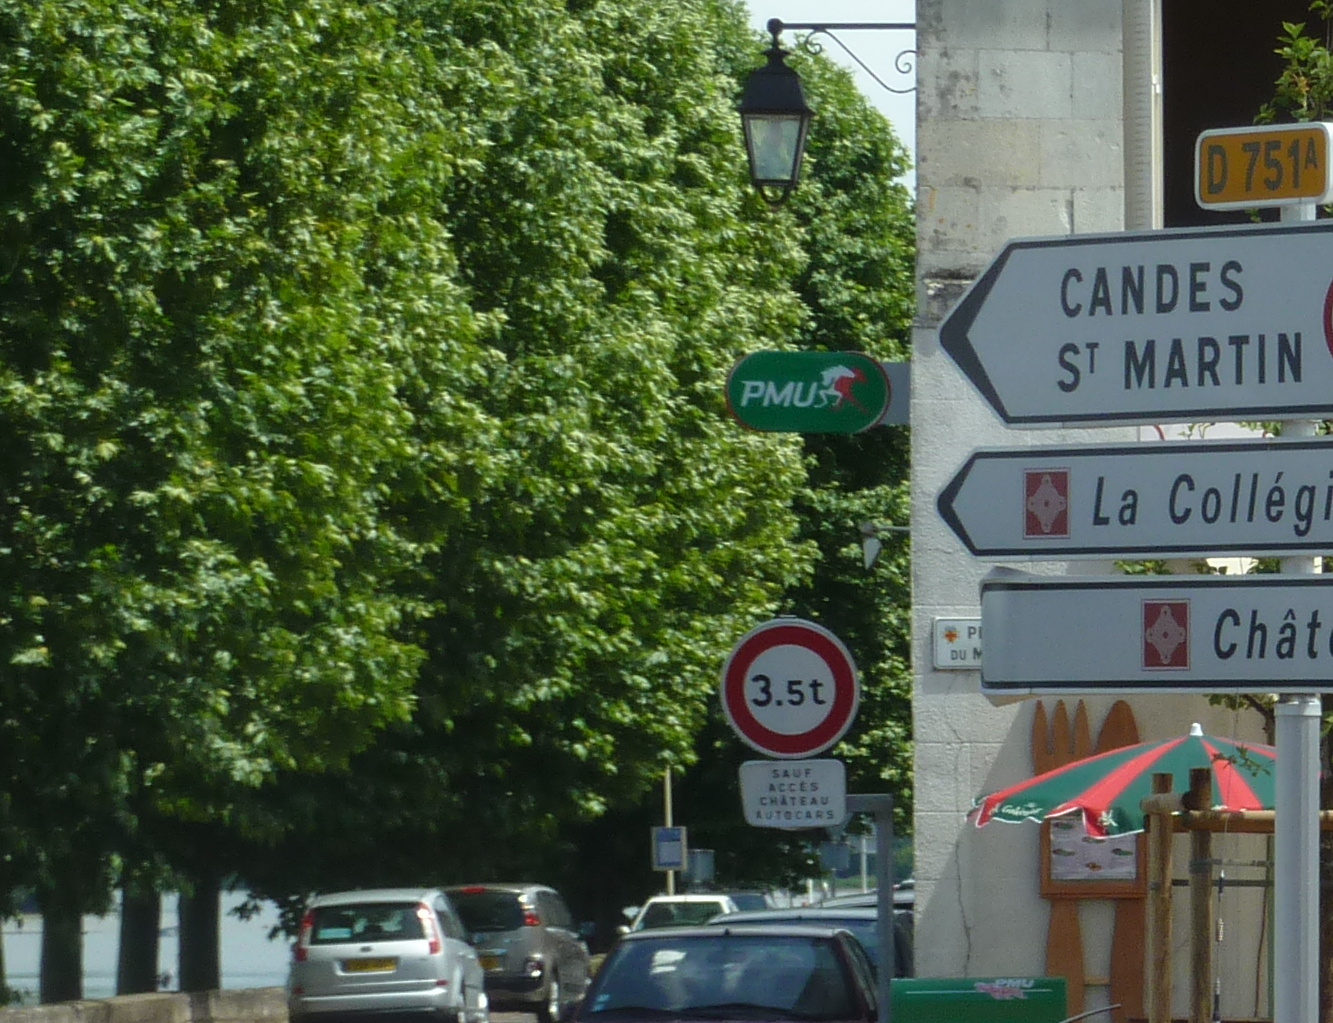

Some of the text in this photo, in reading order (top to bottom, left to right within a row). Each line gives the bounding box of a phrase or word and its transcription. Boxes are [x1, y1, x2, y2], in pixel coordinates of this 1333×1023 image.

[1206, 146, 1228, 194] D
[1060, 261, 1244, 317] CANDES
[1124, 331, 1302, 390] MARTIN
[740, 380, 817, 407] PMU
[1093, 476, 1137, 526] La
[772, 769, 812, 778] SAUF
[756, 810, 834, 820] AUTOCARS
